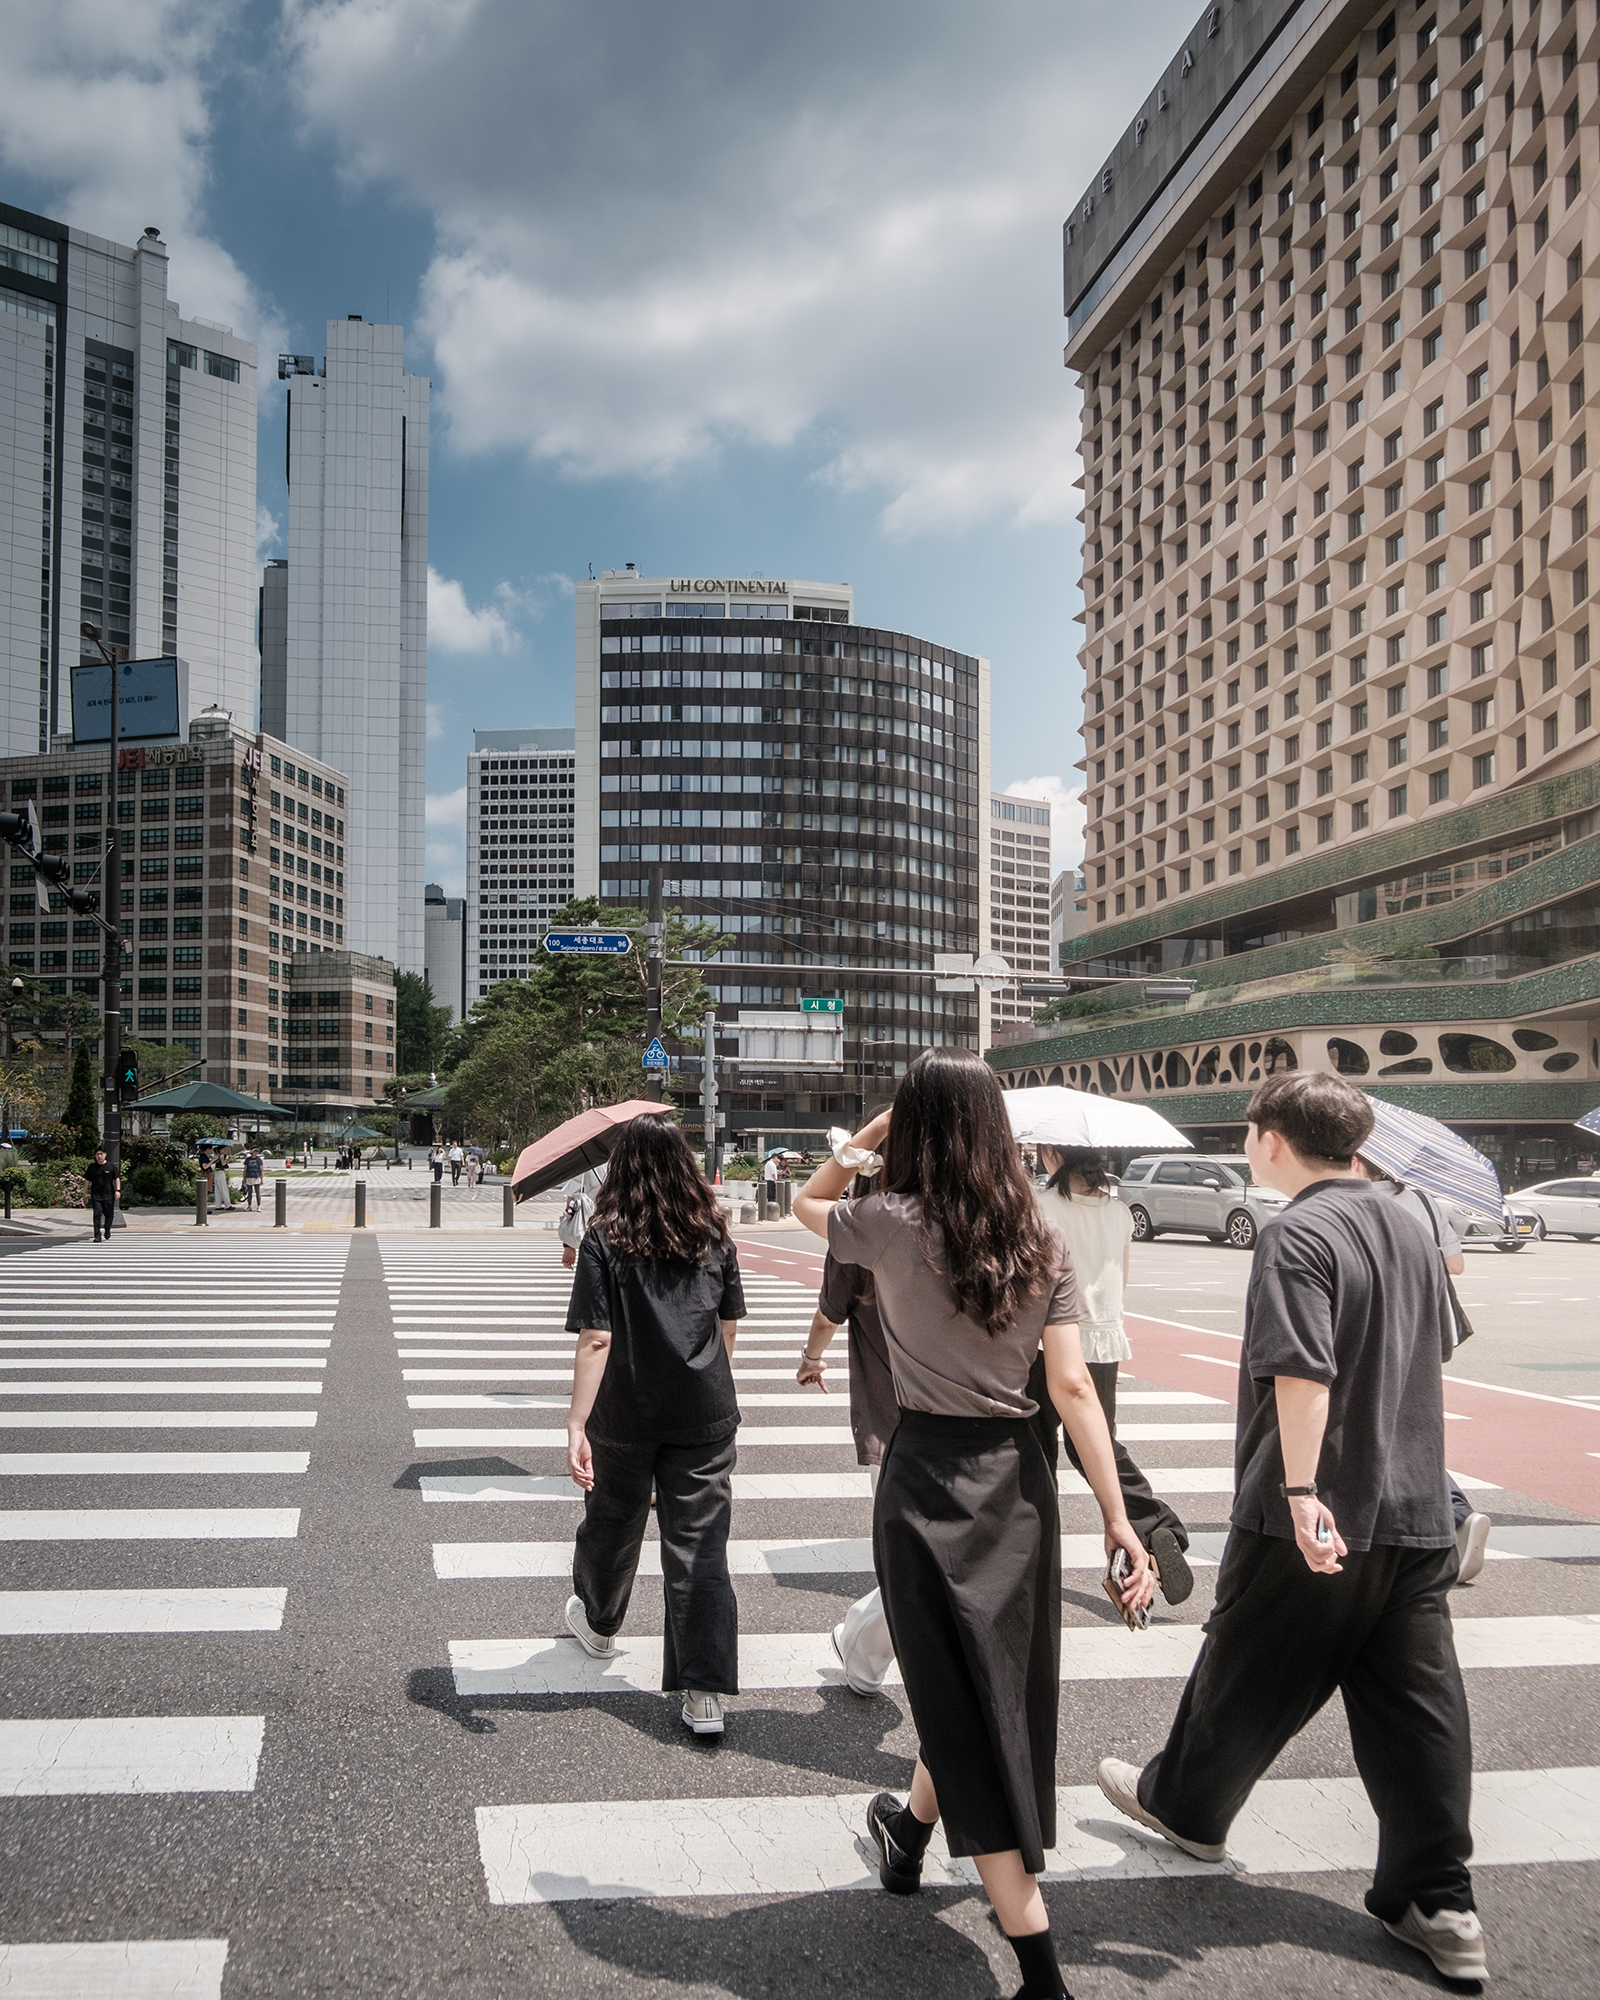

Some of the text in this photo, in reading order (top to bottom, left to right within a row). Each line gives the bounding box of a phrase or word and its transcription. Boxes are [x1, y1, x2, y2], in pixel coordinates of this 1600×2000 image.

[1064, 0, 1241, 246] THE PLAZ
[670, 579, 789, 594] UH CONTINENTAL
[117, 744, 203, 769] JEI 재능교육
[244, 747, 264, 772] JEI
[548, 936, 627, 948] 100 세종대로 96
